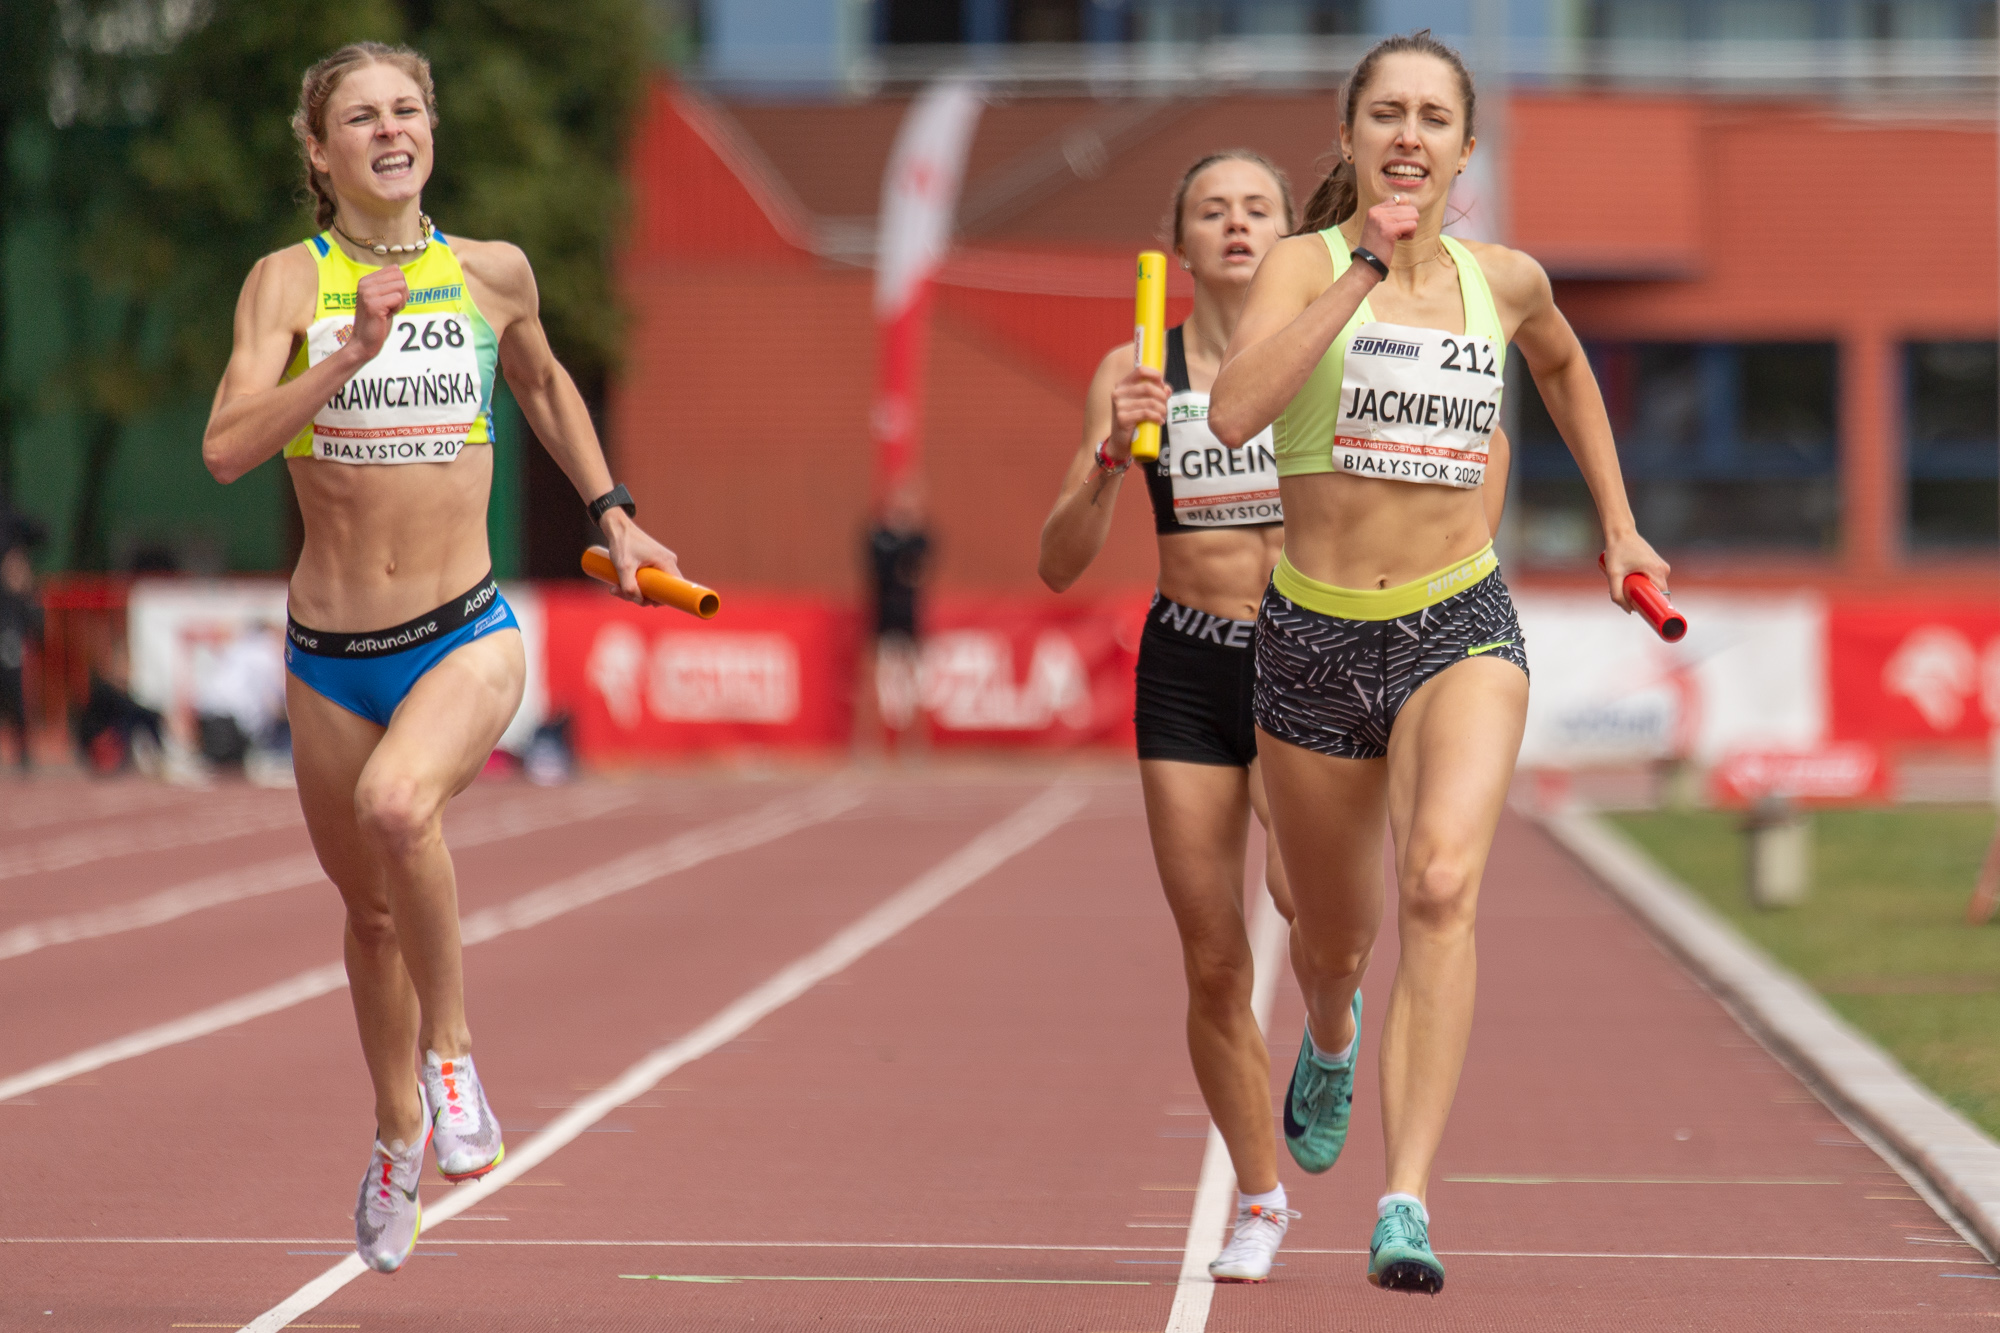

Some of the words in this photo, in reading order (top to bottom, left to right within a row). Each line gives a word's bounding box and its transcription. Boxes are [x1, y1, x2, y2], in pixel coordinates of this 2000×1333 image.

[408, 286, 462, 305] SONAROL
[397, 318, 465, 352] 268
[1352, 338, 1421, 359] SONAROL
[1440, 338, 1496, 378] 212
[1346, 387, 1496, 434] JACKIEWICZ
[339, 428, 396, 439] MISTRZOSTWA
[397, 427, 425, 436] POLSKI
[323, 442, 426, 460] BIAŁYSTOK
[1339, 437, 1362, 448] PZLA
[1363, 440, 1422, 454] MISTRZOSTWA
[1424, 447, 1450, 457] POLSKI
[1343, 454, 1449, 480] BIAŁYSTOK
[1454, 466, 1481, 485] 2022
[1186, 503, 1283, 522] BIAŁYSTOK
[1427, 564, 1473, 598] NIKE
[1159, 602, 1256, 649] NIKE
